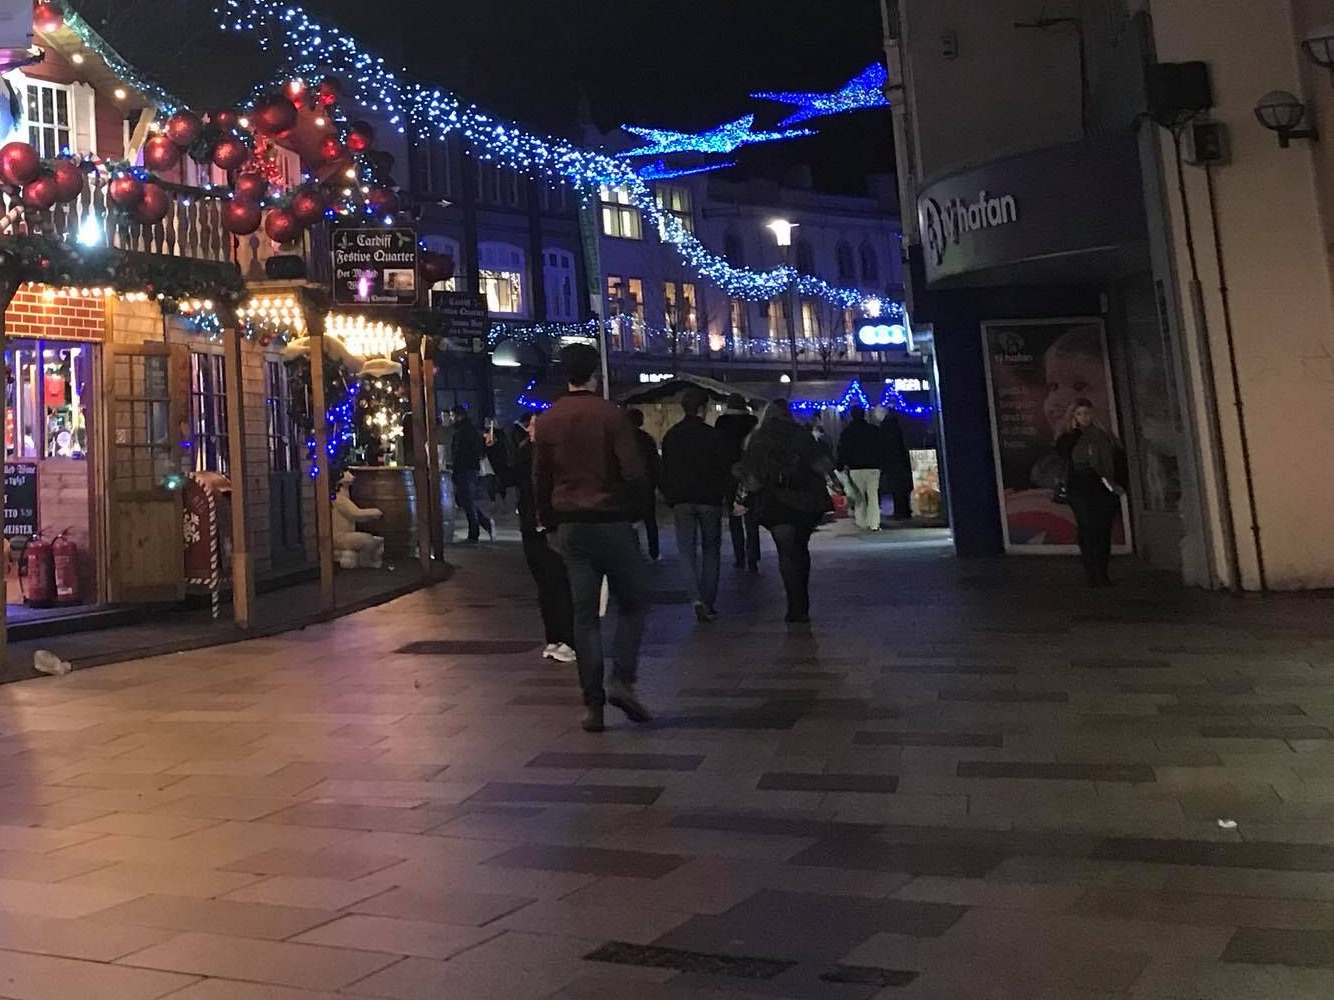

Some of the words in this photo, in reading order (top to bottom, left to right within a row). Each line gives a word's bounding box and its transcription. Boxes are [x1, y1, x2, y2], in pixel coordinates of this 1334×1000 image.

[357, 233, 393, 248] Cardiff
[336, 249, 371, 263] Festive
[374, 249, 415, 262] Quarter
